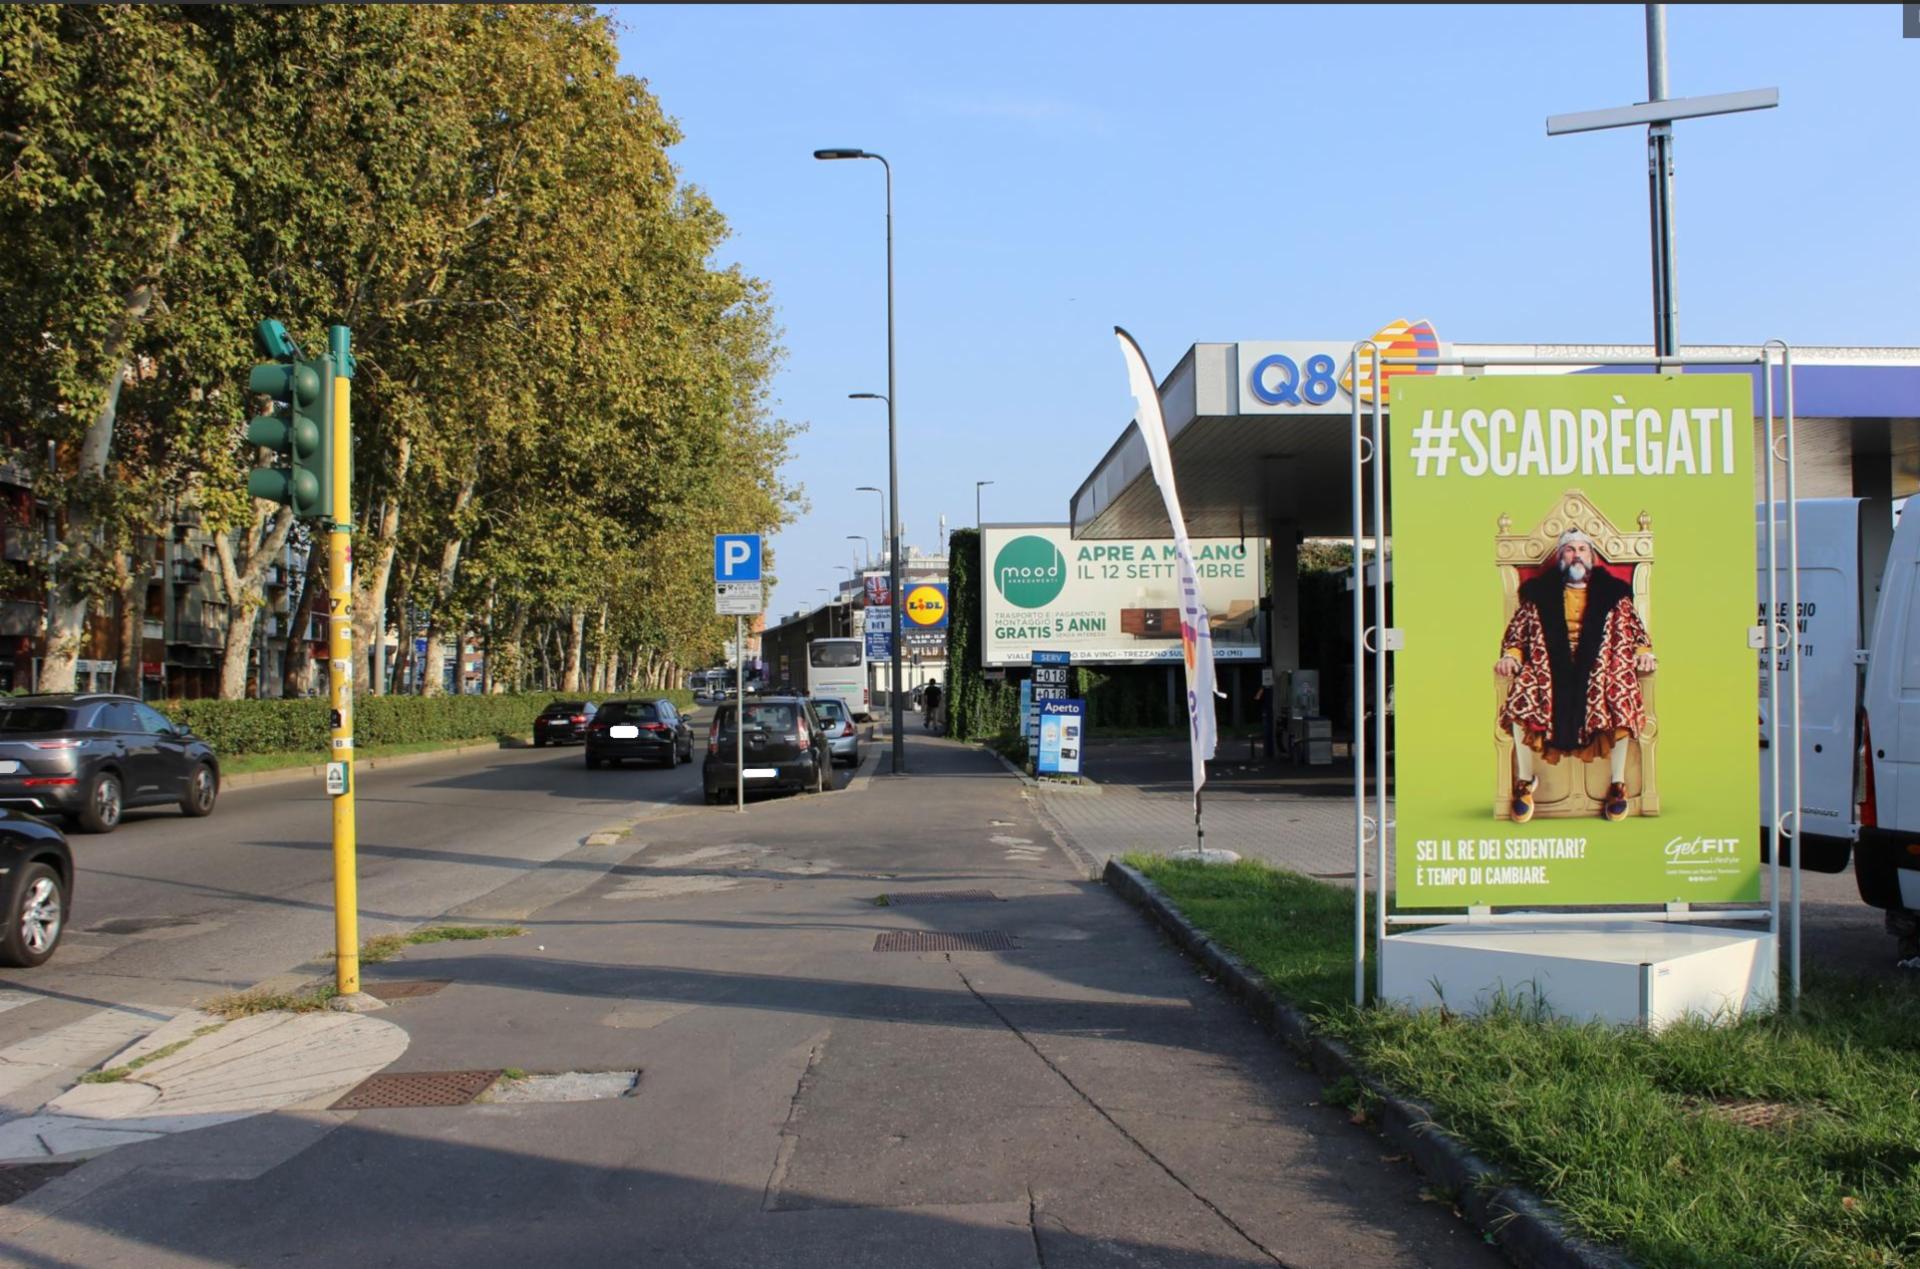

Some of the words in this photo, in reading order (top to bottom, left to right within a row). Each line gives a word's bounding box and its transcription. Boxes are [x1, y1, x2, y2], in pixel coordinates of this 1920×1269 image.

[1252, 353, 1337, 406] Q8
[1409, 395, 1734, 477] #SCADRÈGATI
[724, 541, 752, 576] P
[1077, 545, 1135, 561] APRE
[1140, 545, 1156, 561] A
[1001, 544, 1058, 598] mood
[1077, 565, 1095, 580] IL
[1101, 564, 1120, 579] 12
[1126, 563, 1245, 579] SETTMBRE
[995, 612, 1042, 620] TRASPORTO
[995, 626, 1052, 639] GRATIS
[1055, 618, 1064, 632] 5
[1068, 618, 1106, 632] ANNI
[1007, 652, 1030, 660] VIALE
[1044, 702, 1080, 714] Aperto
[1416, 840, 1438, 861] SEI
[1442, 840, 1455, 861] IL
[1458, 839, 1475, 860] RE
[1479, 839, 1501, 860] DEI
[1504, 838, 1587, 860] SEDENTARI?
[1416, 865, 1424, 886] È
[1426, 867, 1467, 886] TEMPO
[1470, 866, 1482, 885] DI
[1485, 866, 1550, 885] CAMBIARE.
